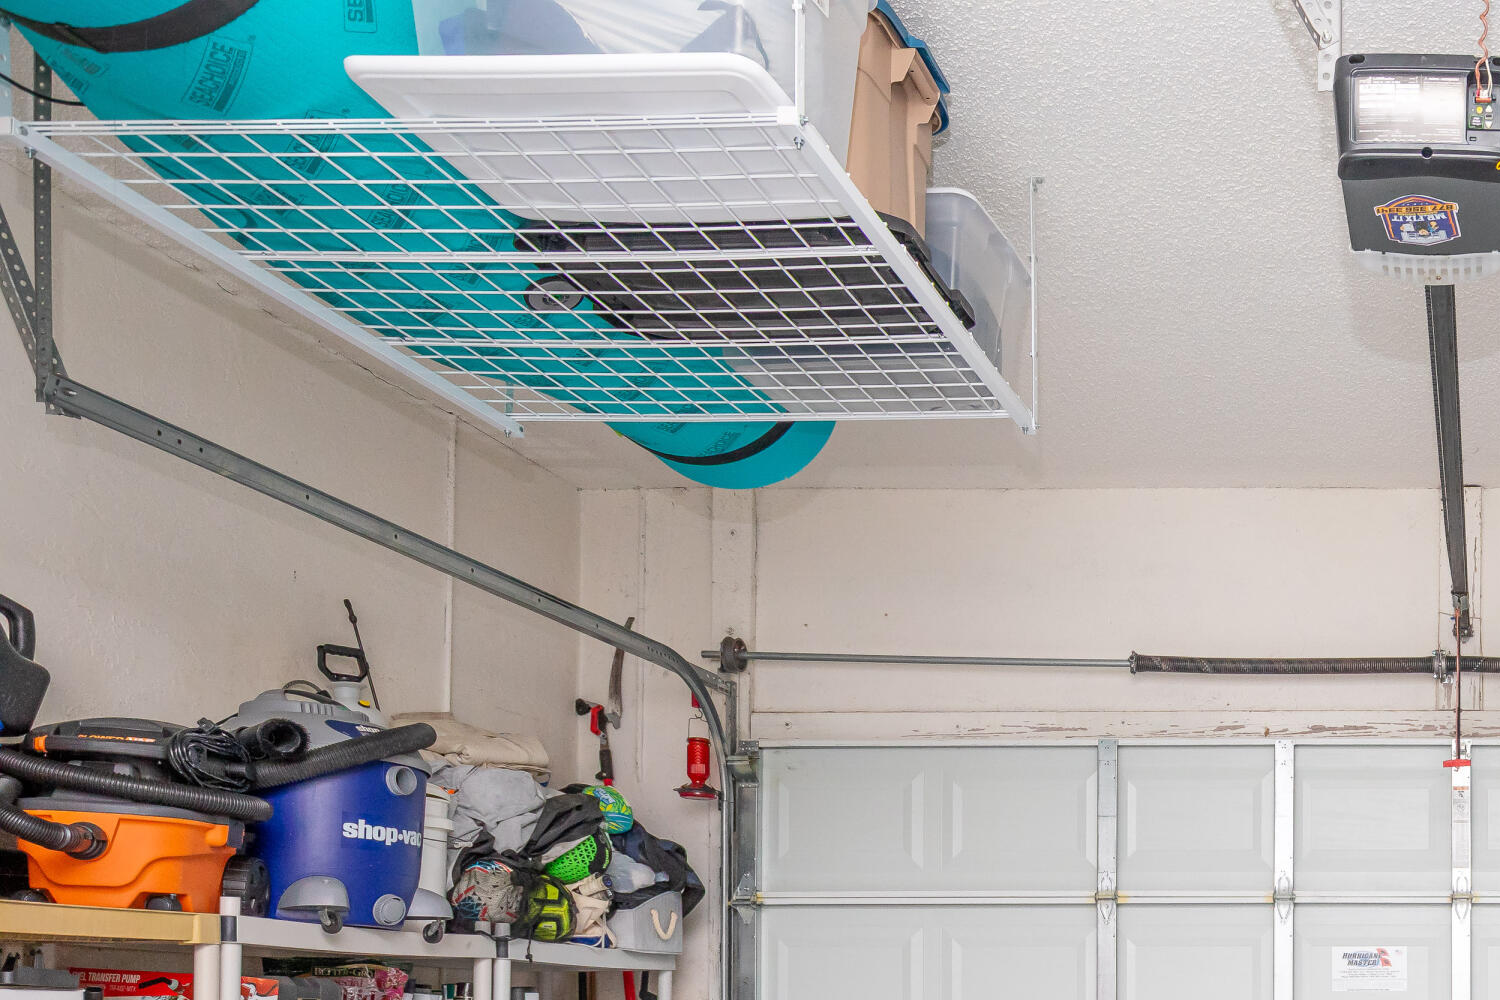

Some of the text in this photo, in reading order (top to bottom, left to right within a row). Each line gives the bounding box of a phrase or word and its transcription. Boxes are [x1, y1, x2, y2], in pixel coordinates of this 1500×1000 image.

[191, 39, 235, 107] SEACHOICE
[88, 972, 121, 983] TRANSFER
[121, 974, 140, 984] PUMP
